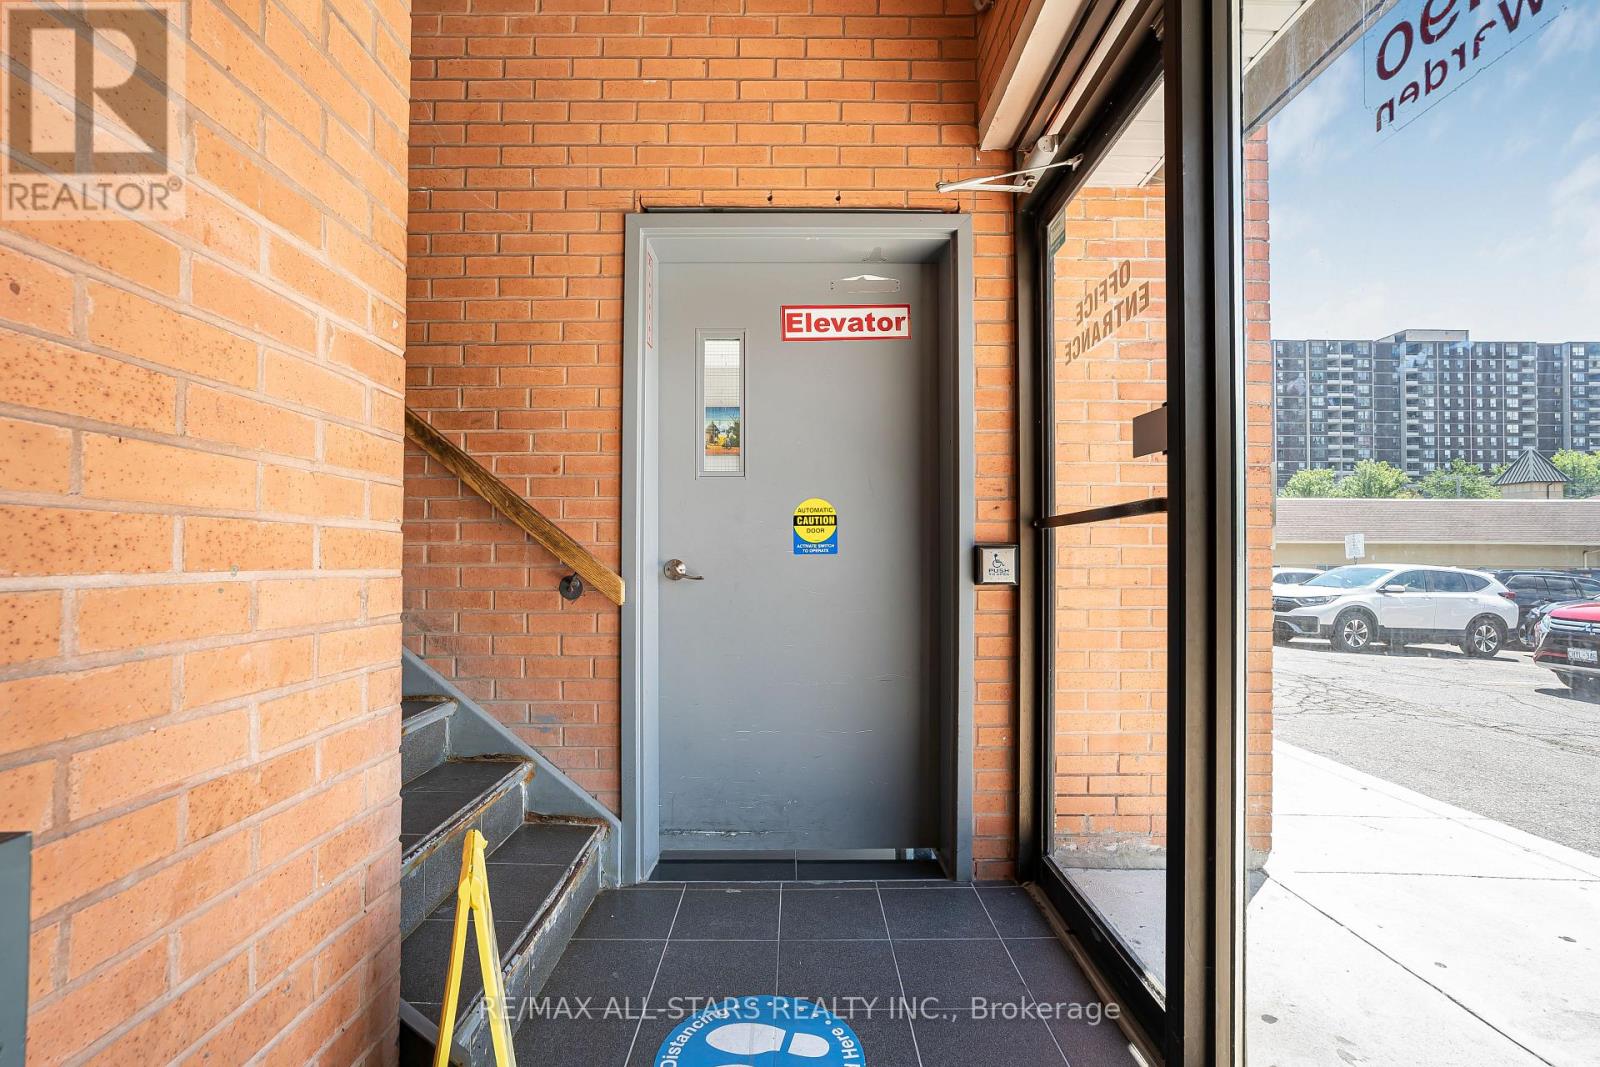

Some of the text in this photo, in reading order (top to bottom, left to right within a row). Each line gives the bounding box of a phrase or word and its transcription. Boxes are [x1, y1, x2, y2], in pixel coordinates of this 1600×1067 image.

[786, 312, 906, 332] Elevator
[797, 515, 835, 525] CAUTION
[832, 1027, 860, 1060] Here
